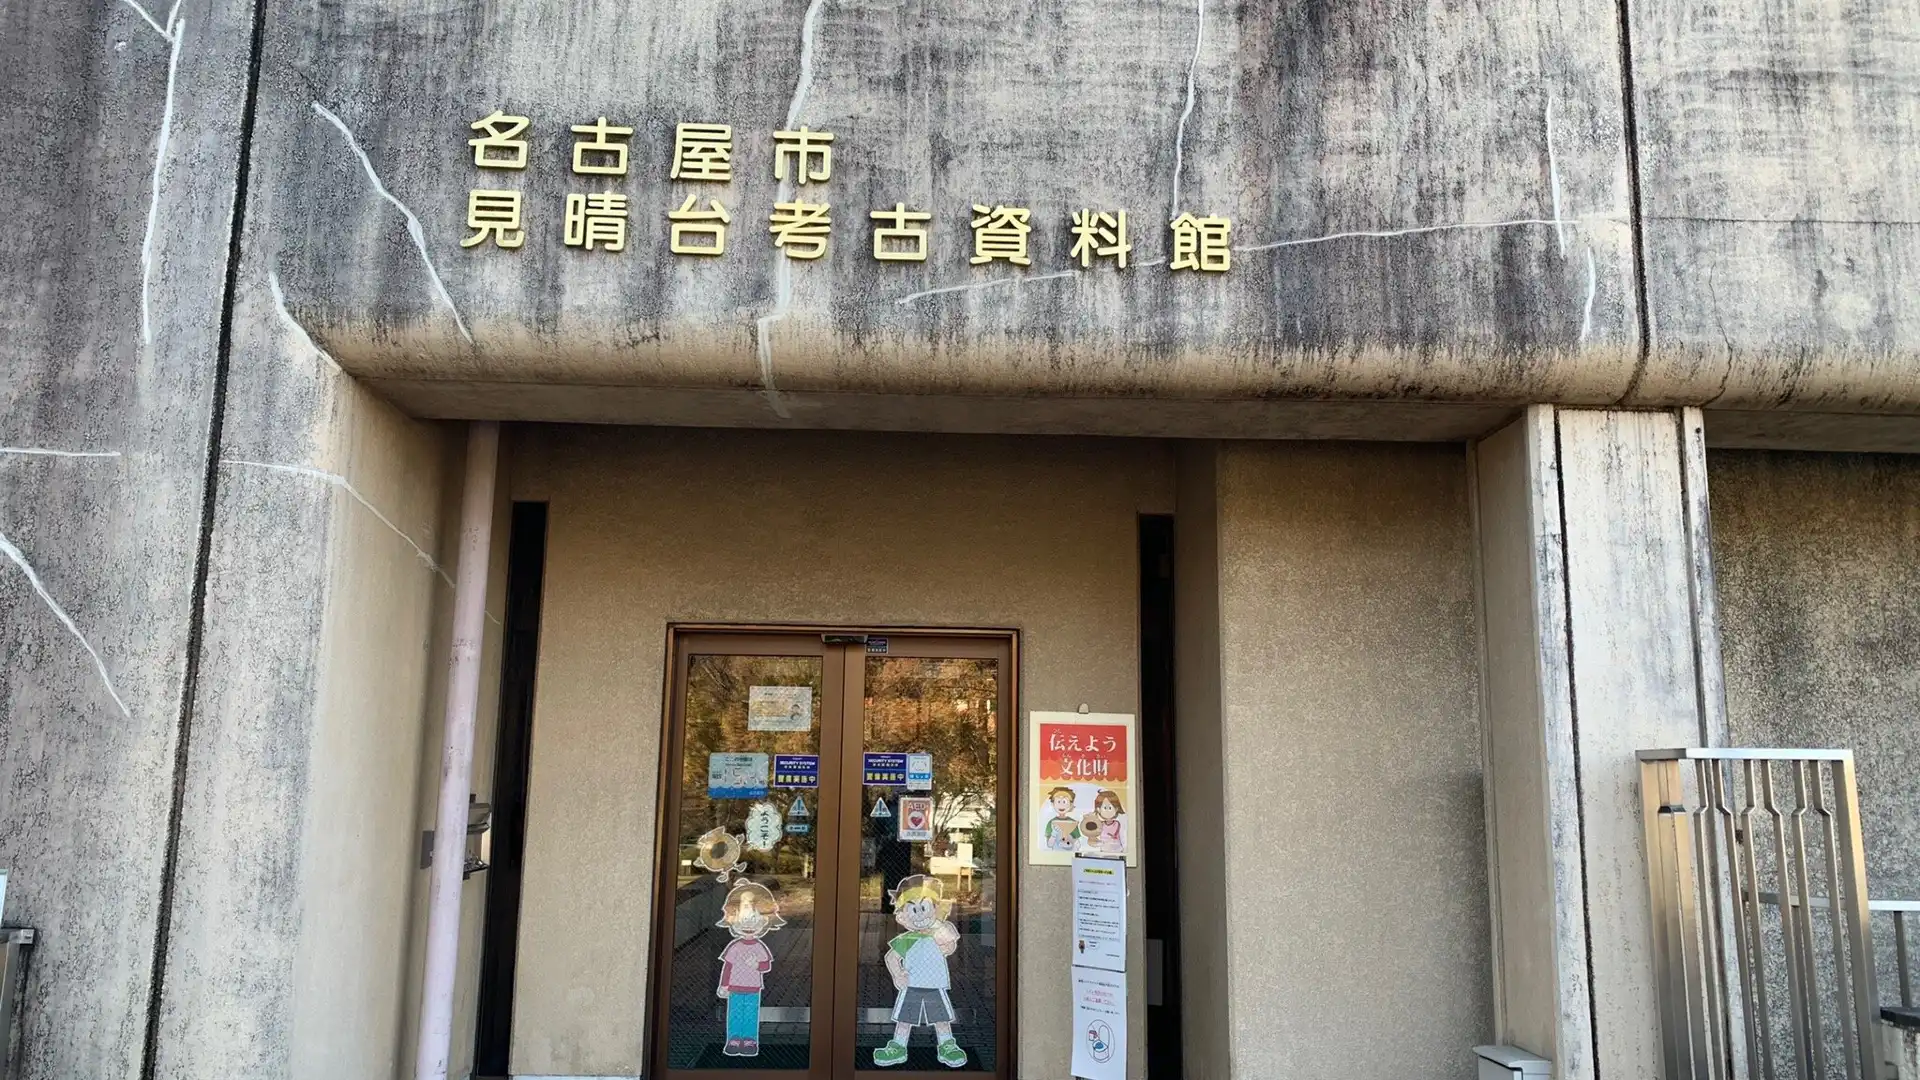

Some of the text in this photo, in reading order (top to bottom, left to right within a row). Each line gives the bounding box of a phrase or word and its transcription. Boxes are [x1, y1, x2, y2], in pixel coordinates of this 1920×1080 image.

[469, 110, 835, 185] 名古屋市
[460, 188, 1232, 272] 見晴台考古資料館
[1049, 733, 1117, 752] 伝えよう
[1060, 758, 1108, 776] 文化財
